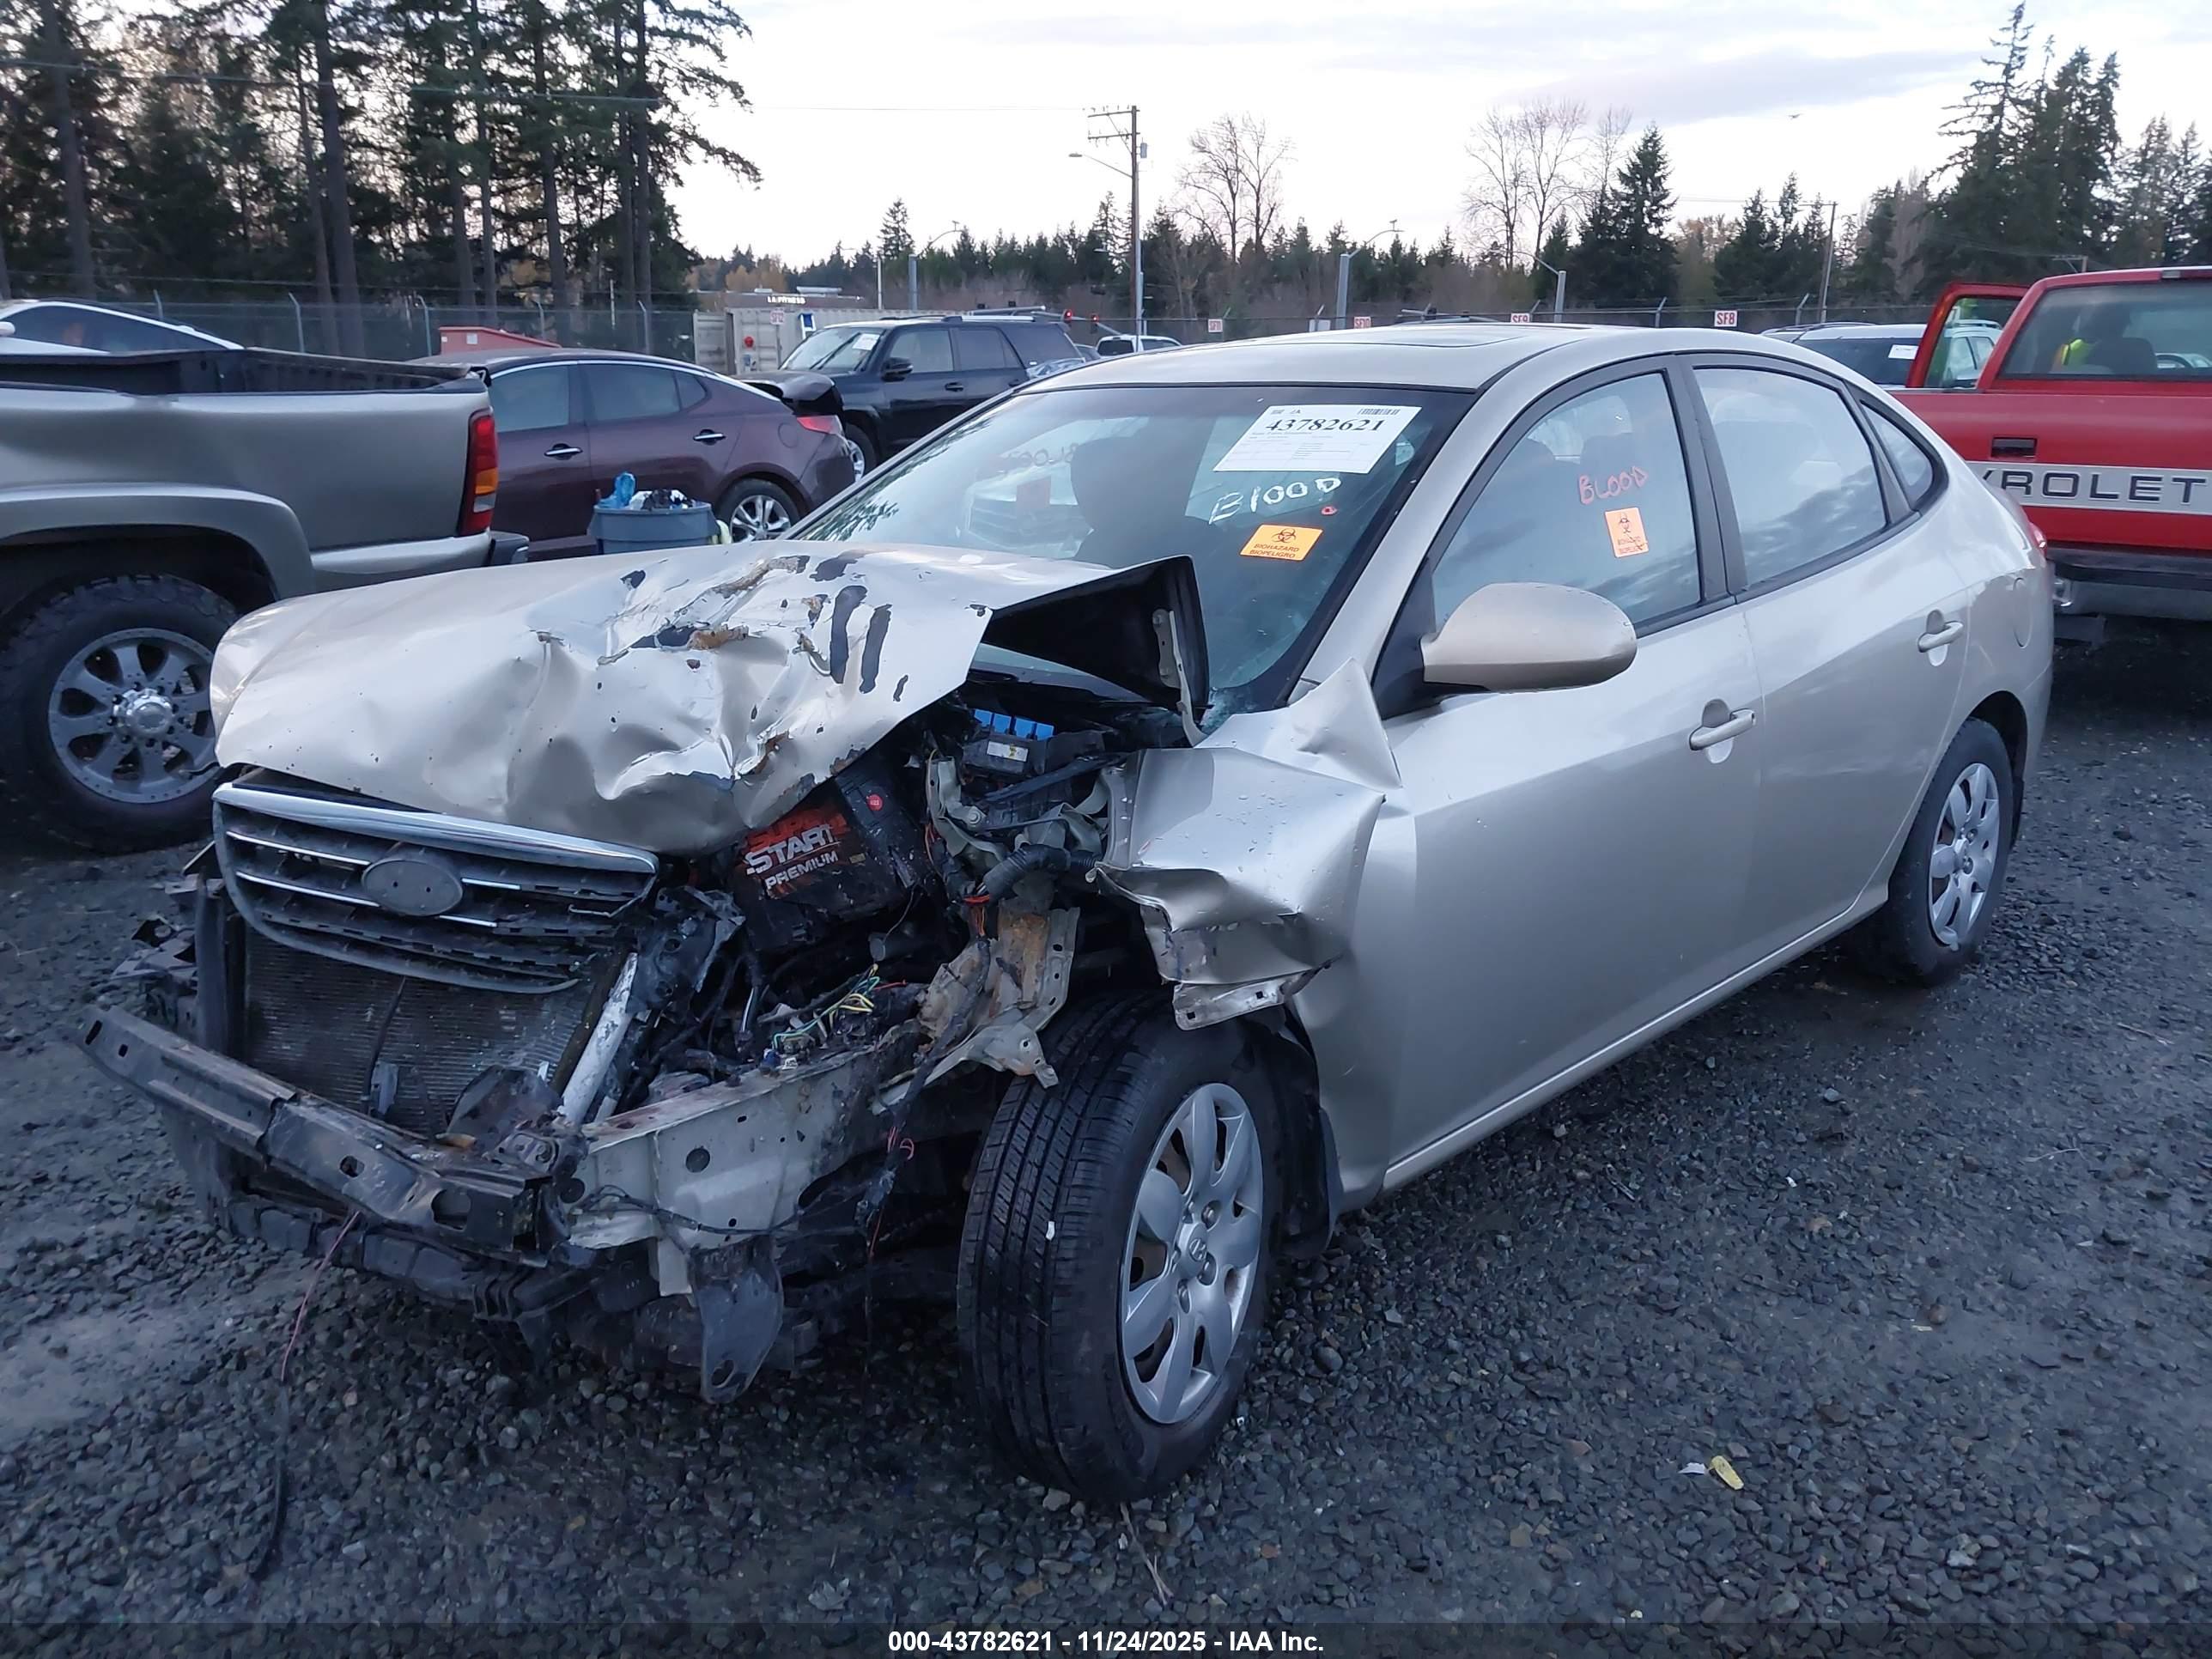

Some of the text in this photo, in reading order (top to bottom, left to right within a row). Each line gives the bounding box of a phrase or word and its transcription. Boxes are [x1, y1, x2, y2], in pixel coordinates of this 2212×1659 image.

[1717, 312, 1735, 325] SF8
[1266, 418, 1386, 431] 43782621
[1578, 465, 1649, 505] BLOOD
[1249, 550, 1296, 558] BIOPELIGRO
[1254, 544, 1300, 552] BIOHAZARD
[744, 823, 835, 874] START
[764, 850, 839, 889] PREMIUM
